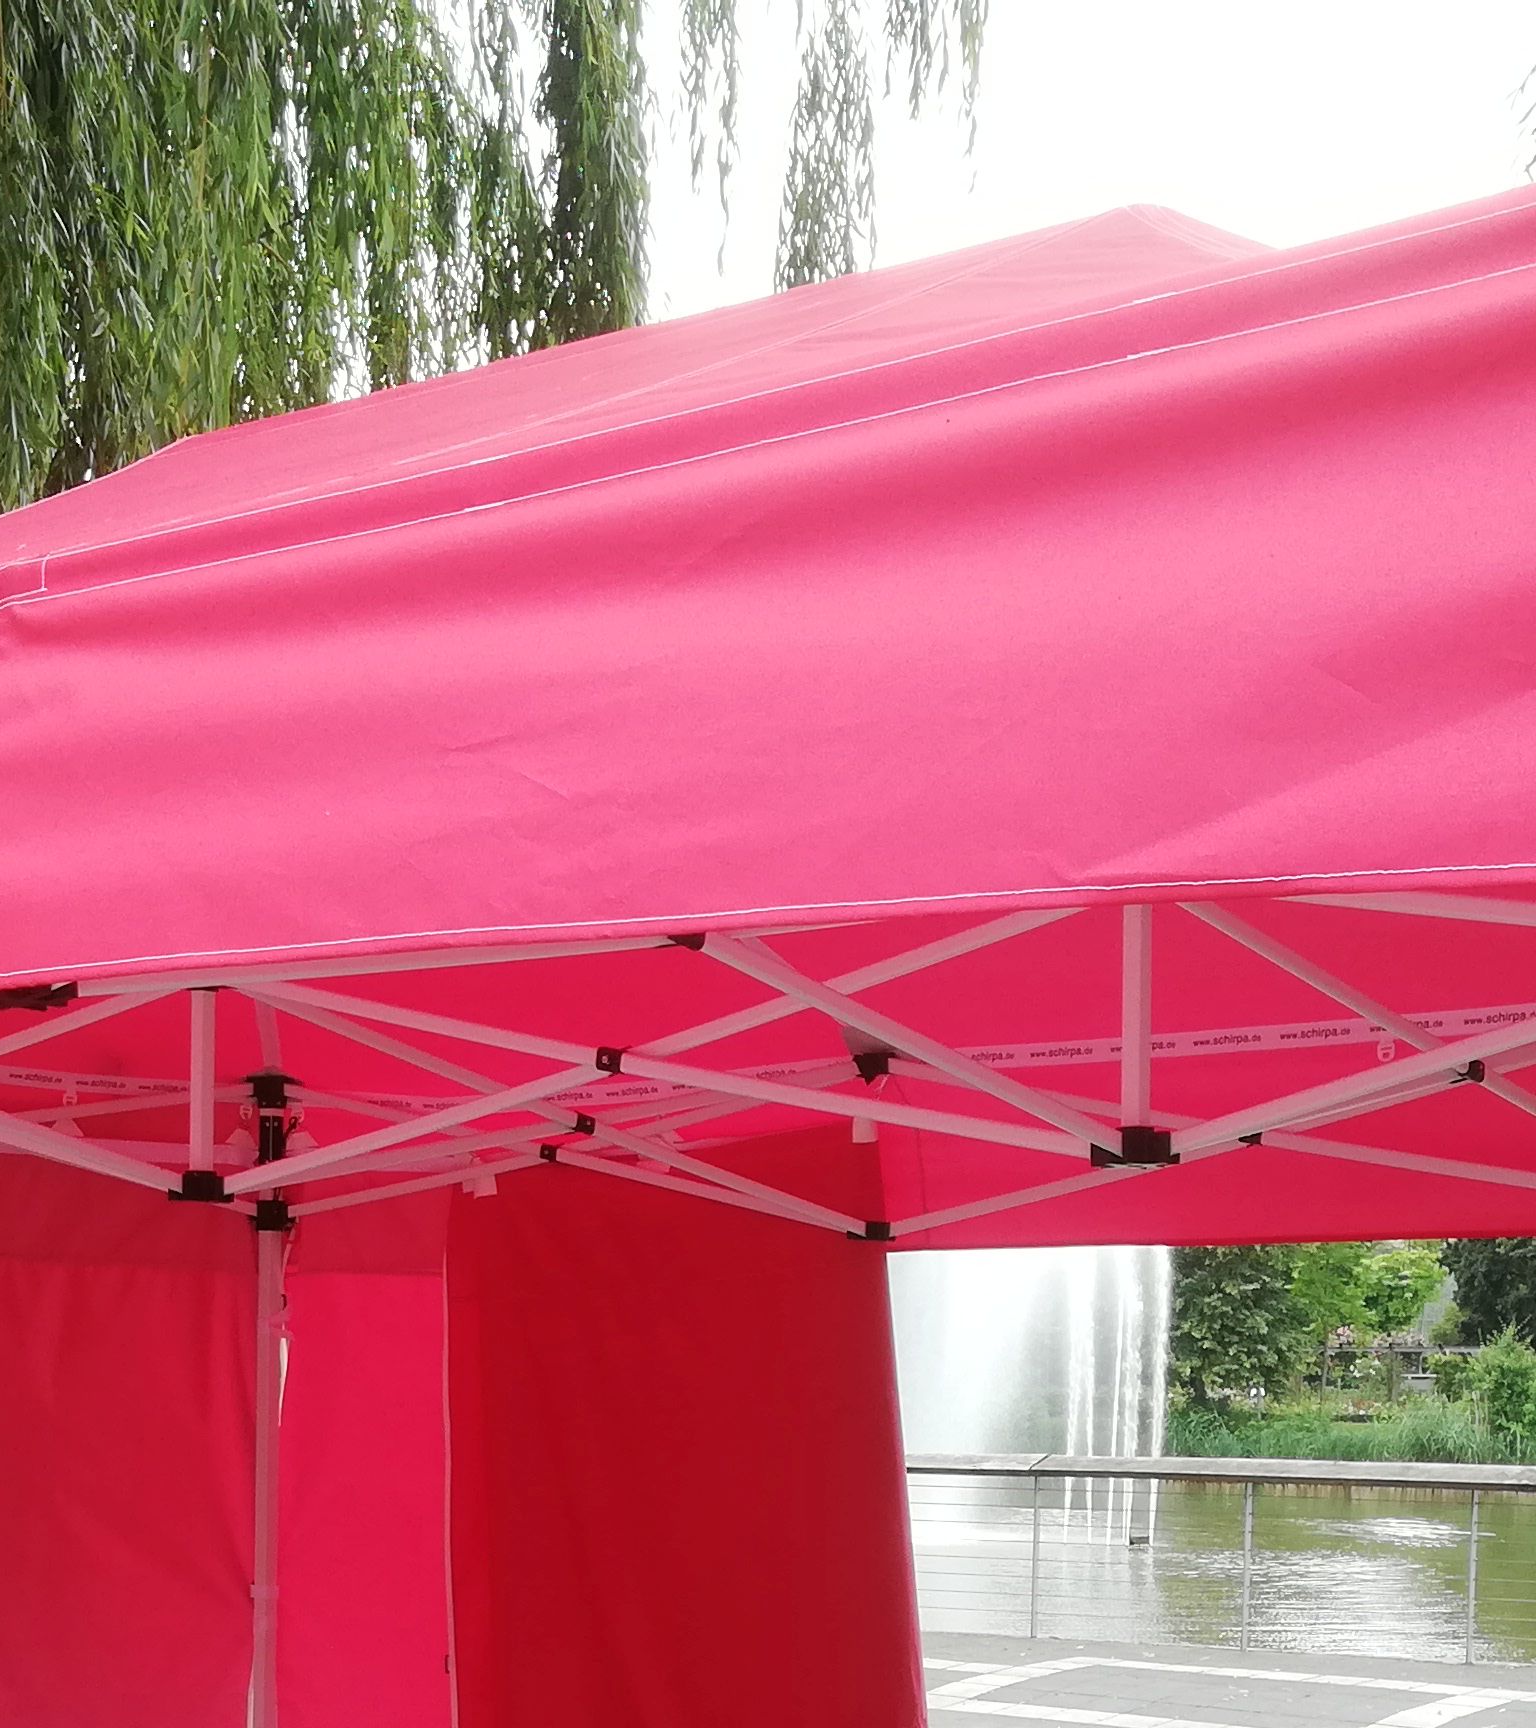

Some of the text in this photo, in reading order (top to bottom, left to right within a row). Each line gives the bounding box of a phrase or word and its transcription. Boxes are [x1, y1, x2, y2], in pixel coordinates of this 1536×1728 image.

[1029, 1045, 1093, 1059] www.schirpa.de
[1192, 1032, 1262, 1048] www.schirpa.de
[1279, 1025, 1351, 1041] www.schirpa.de
